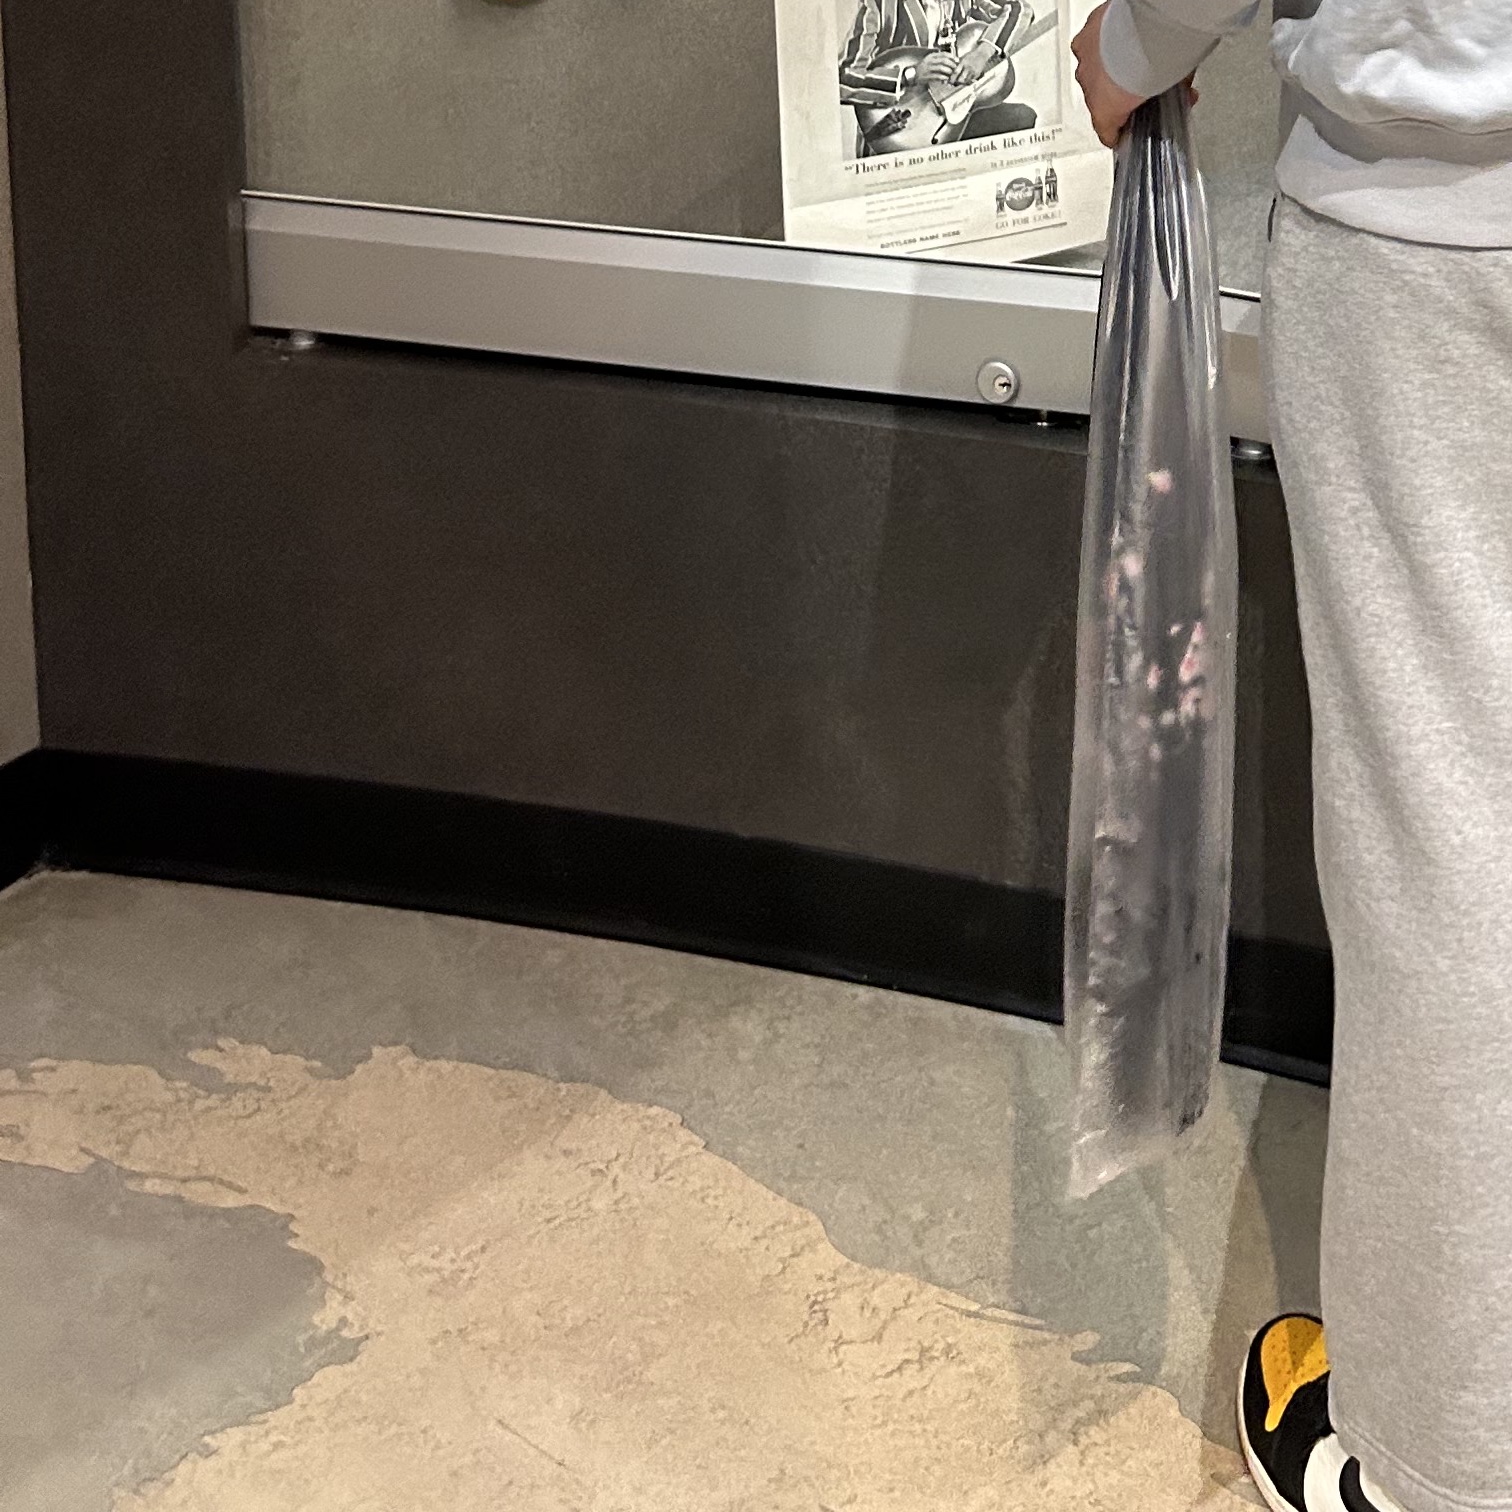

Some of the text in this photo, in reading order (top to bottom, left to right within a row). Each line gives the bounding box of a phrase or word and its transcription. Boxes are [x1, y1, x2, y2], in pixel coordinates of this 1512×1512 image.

[894, 156, 904, 168] is
[909, 155, 924, 164] no
[928, 148, 962, 162] other
[965, 139, 998, 156] drink
[1003, 135, 1026, 149] like
